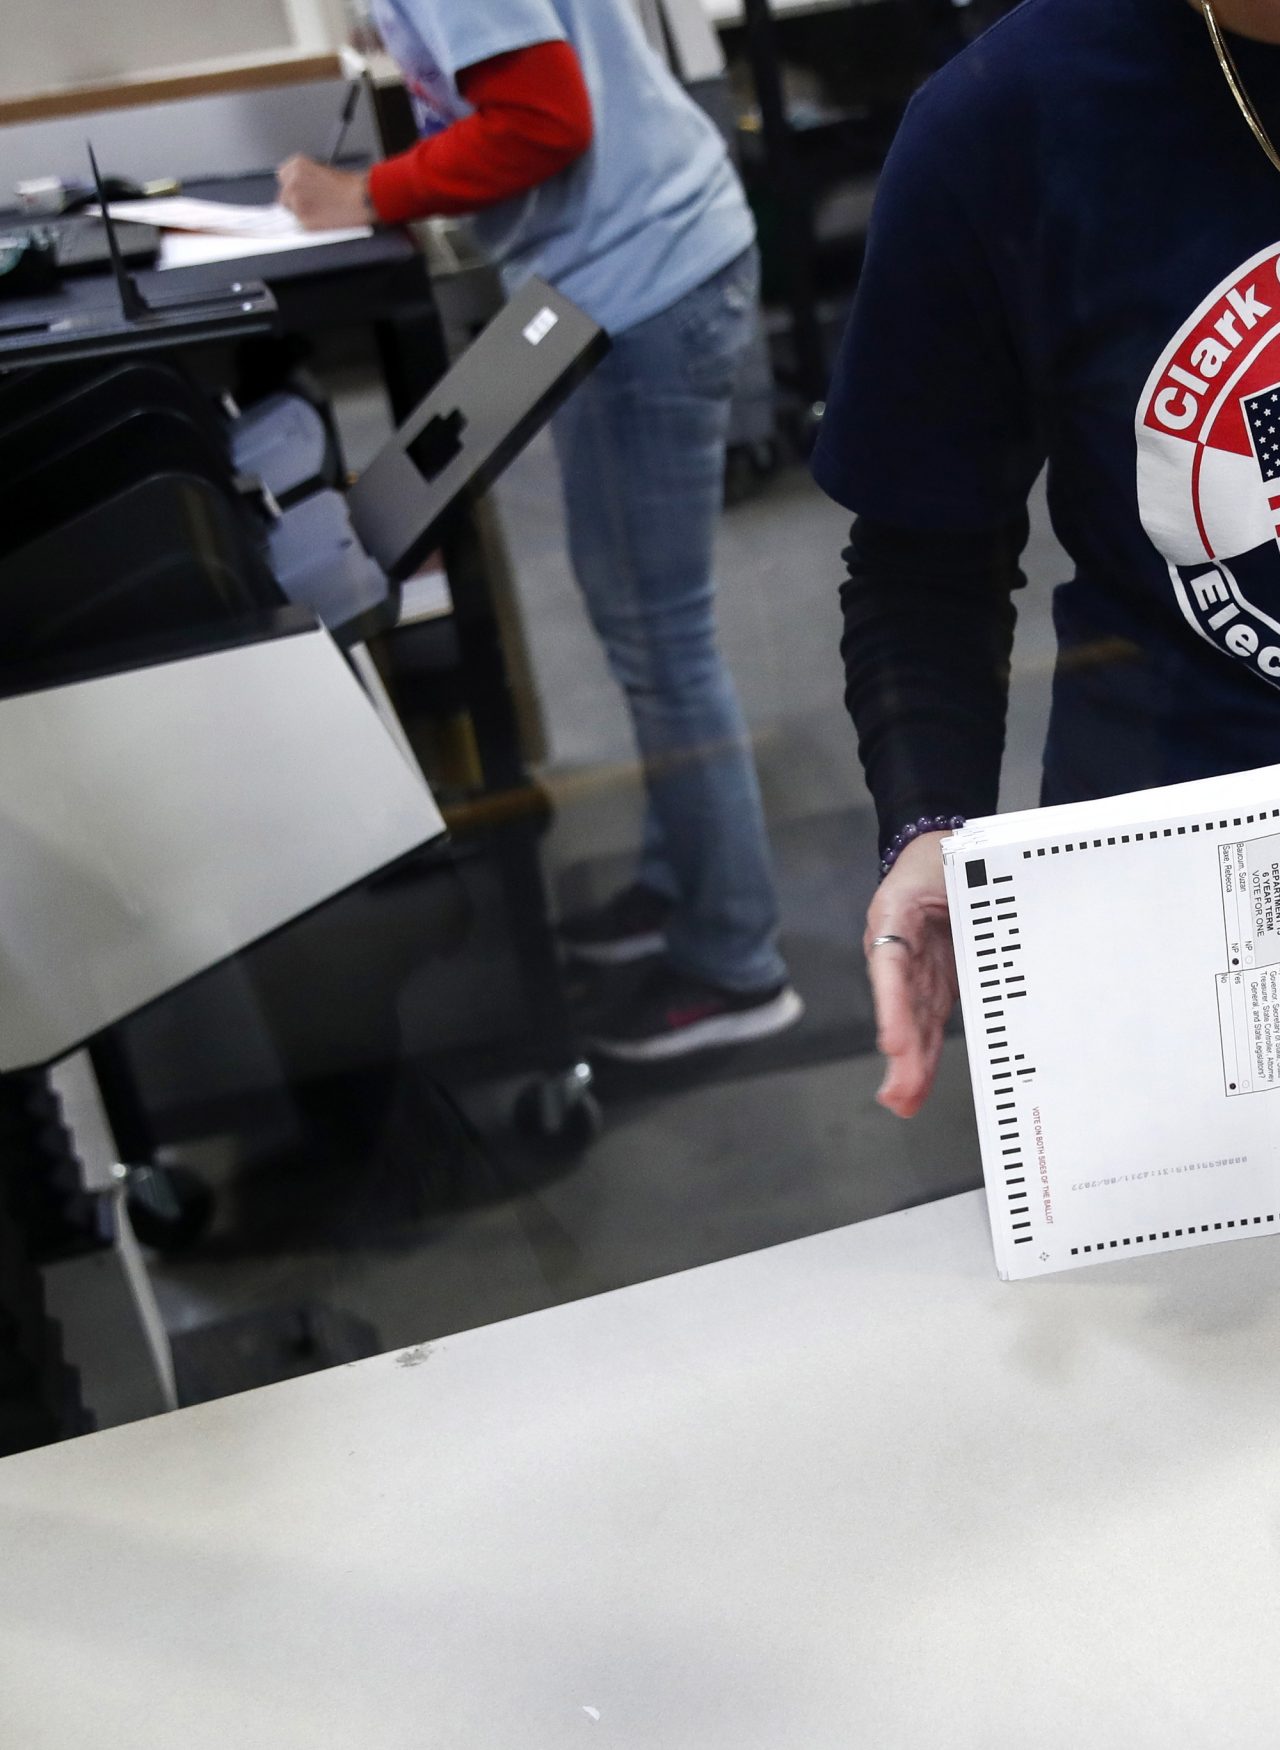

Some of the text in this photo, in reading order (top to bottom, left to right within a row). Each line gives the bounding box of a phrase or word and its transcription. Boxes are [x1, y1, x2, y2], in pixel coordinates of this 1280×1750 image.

[1154, 282, 1272, 431] Clark
[1251, 869, 1265, 937] VOTE FOR ONE
[1262, 878, 1272, 904] YEAR
[1264, 904, 1274, 931] TERM
[1230, 941, 1240, 953] NP
[1031, 1105, 1054, 1224] VOTE ON BOTH SIDES OF THE BALLOT
